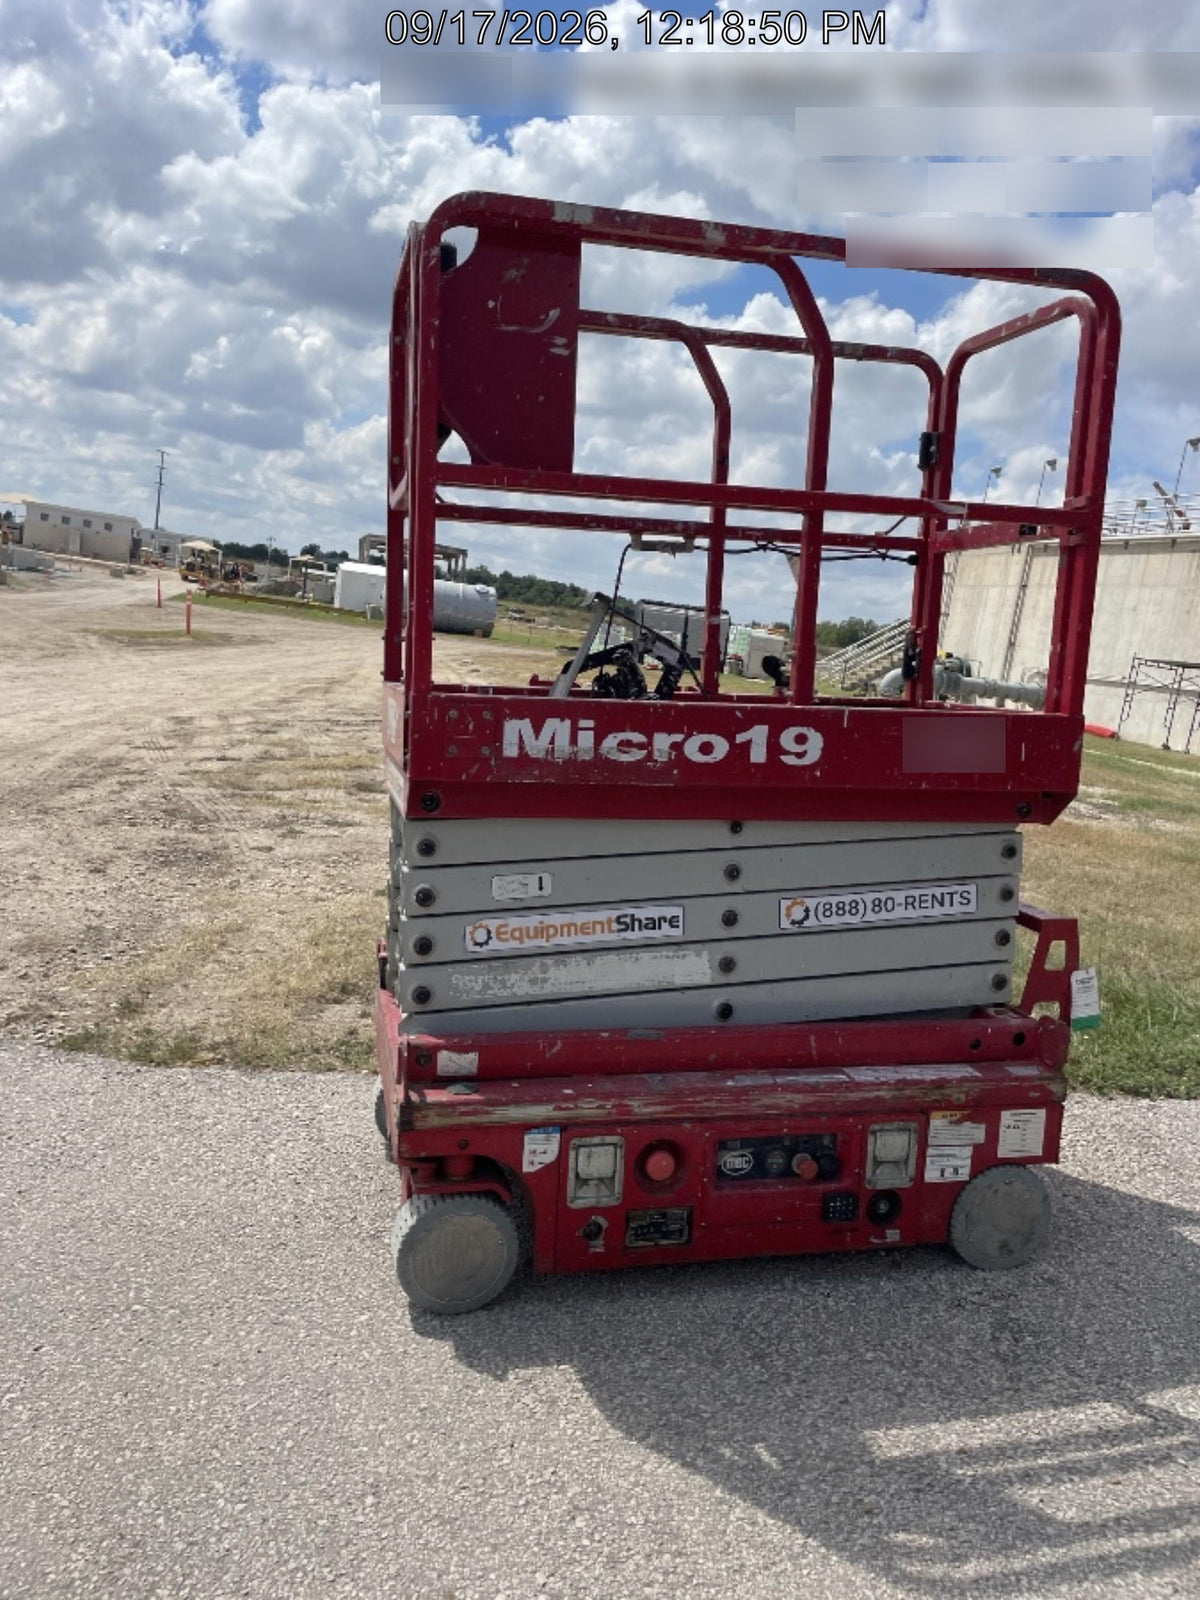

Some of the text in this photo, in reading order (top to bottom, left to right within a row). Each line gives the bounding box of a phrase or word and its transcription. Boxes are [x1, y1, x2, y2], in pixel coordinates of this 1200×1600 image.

[502, 718, 824, 766] Micro19
[814, 890, 972, 922] (888) 80-RENTS
[495, 913, 681, 944] EquipmentShare
